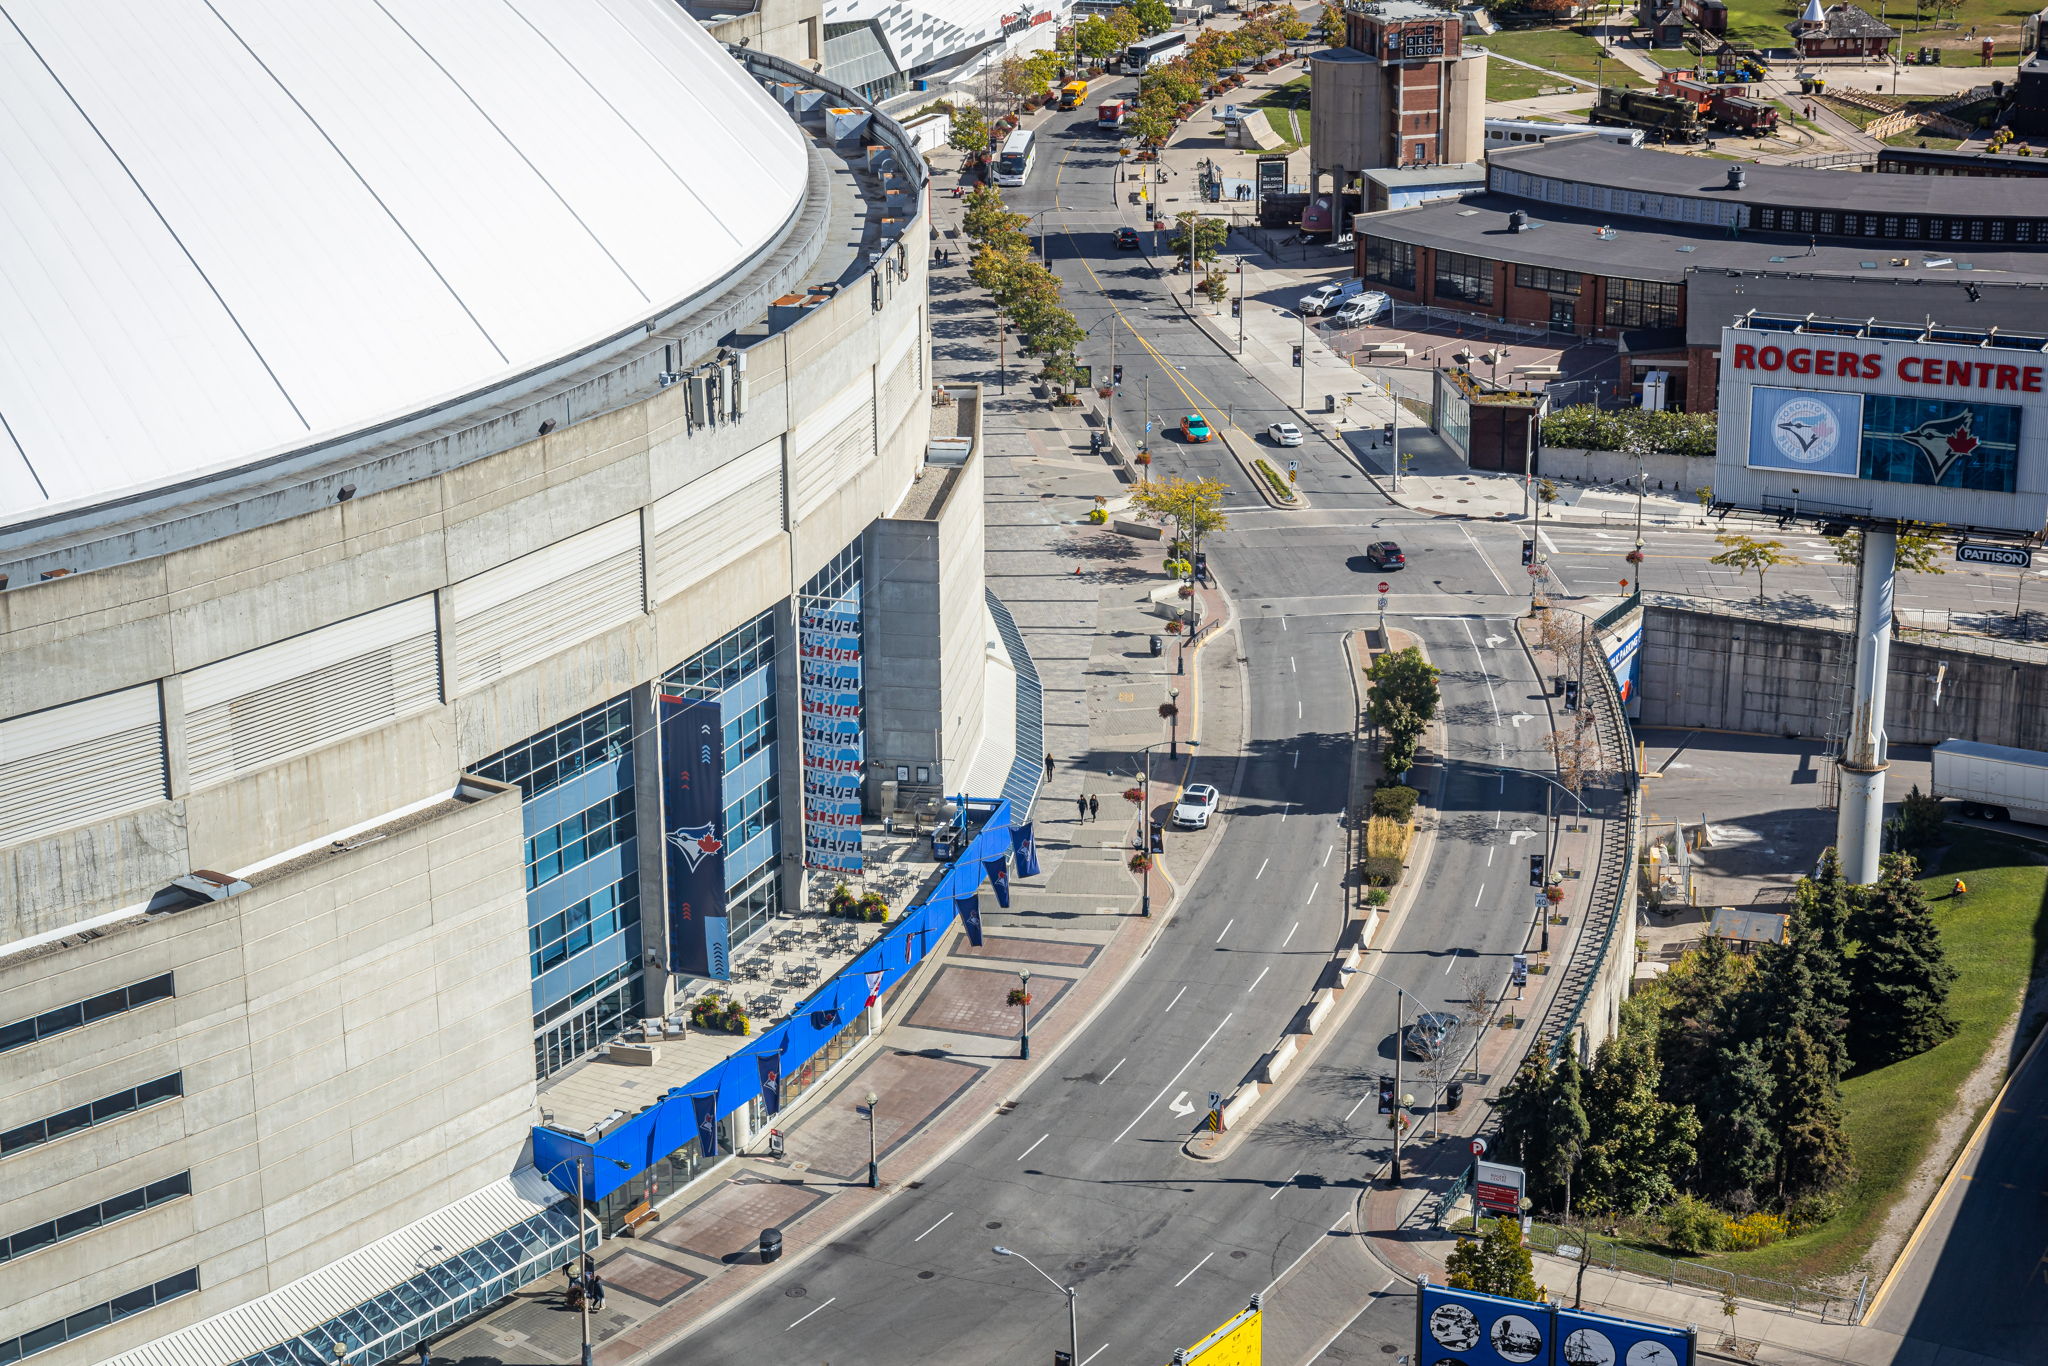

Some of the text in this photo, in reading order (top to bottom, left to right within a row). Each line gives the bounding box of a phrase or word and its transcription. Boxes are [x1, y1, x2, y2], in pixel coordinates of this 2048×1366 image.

[1408, 37, 1433, 45] REC
[1408, 47, 1442, 55] ROOM
[1734, 344, 2043, 393] ROGERS CENTRE
[1964, 549, 2023, 564] PATTISON
[813, 617, 858, 634] LEVEL
[803, 632, 841, 649] NEXT
[813, 645, 858, 661] LEVEL
[803, 660, 841, 677] NEXT
[814, 674, 859, 690] LEVEL
[804, 688, 841, 705] NEXT
[814, 702, 859, 718] LEVEL
[804, 716, 842, 733] NEXT
[814, 730, 859, 746] LEVEL
[805, 742, 842, 760] NEXT
[815, 757, 860, 772] LEVEL
[806, 769, 842, 787] NEXT
[816, 784, 860, 799] LEVEL
[807, 796, 843, 814] NEXT
[816, 811, 861, 826] LEVEL
[808, 823, 844, 841] NEXT
[817, 838, 862, 853] LEVEL
[809, 850, 845, 867] NEXT
[1473, 1143, 1482, 1154] P
